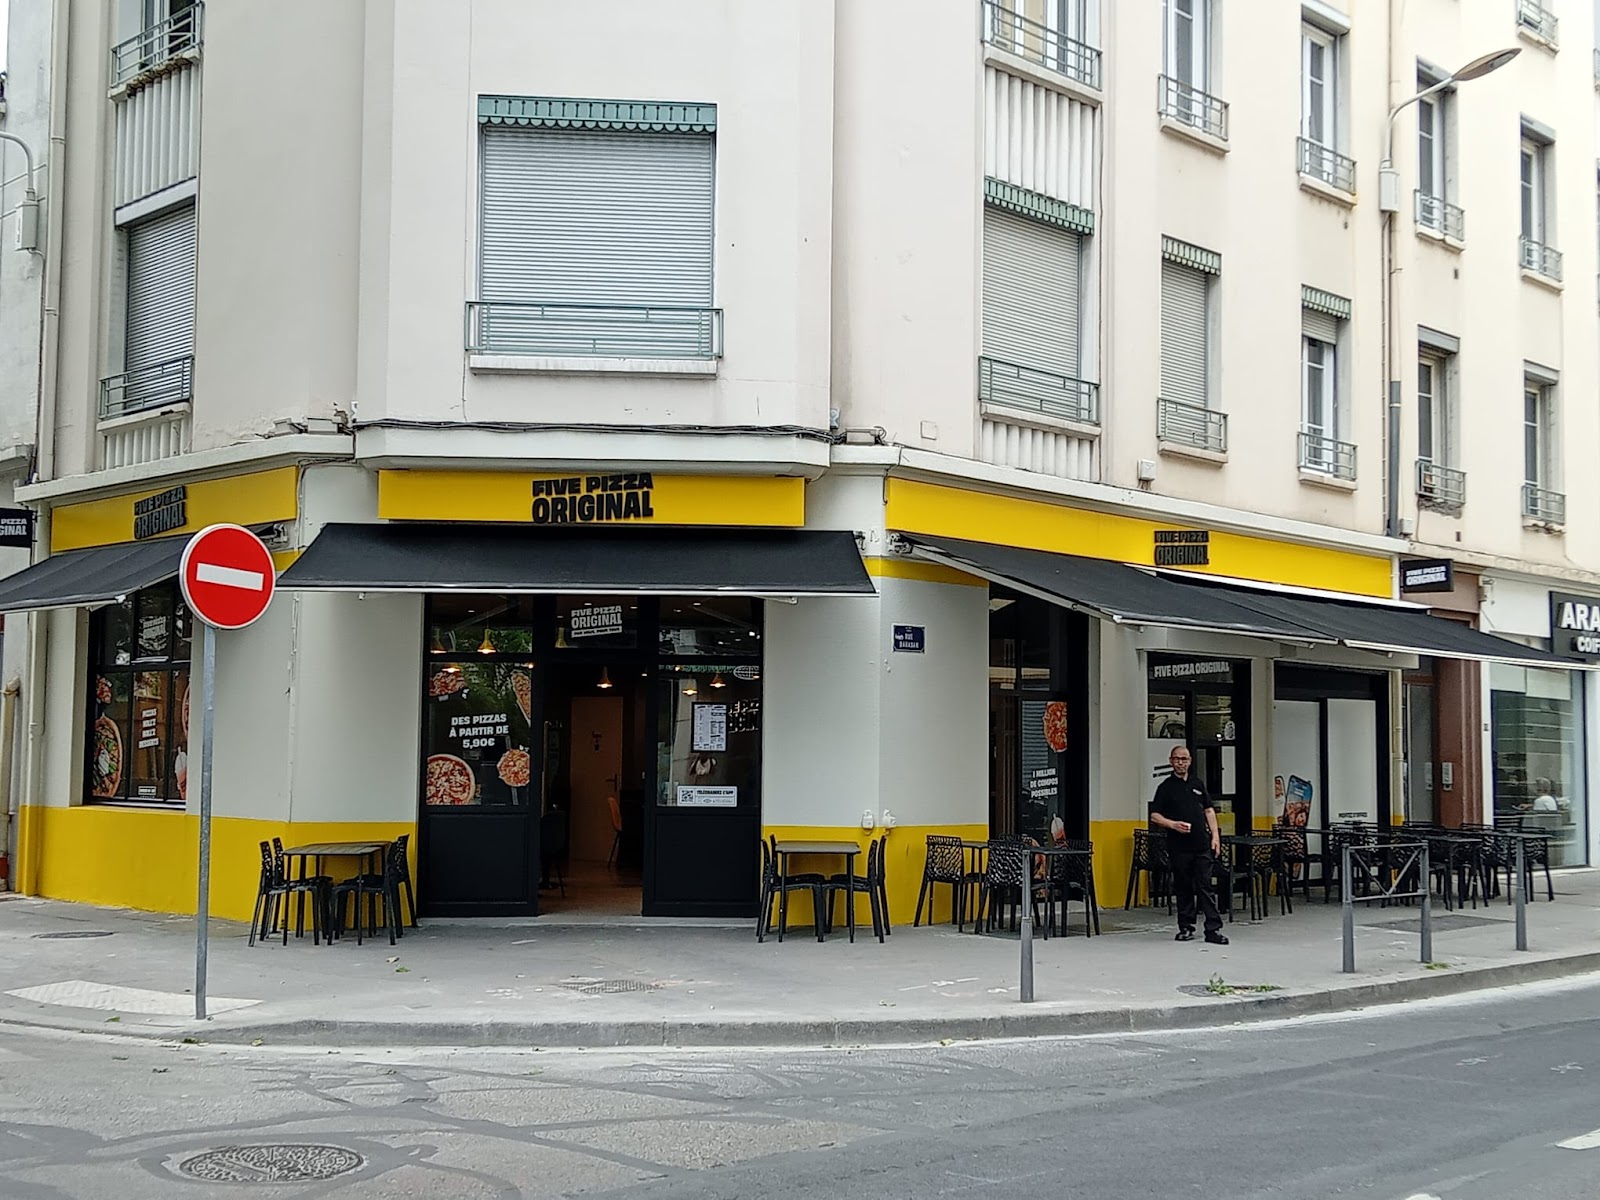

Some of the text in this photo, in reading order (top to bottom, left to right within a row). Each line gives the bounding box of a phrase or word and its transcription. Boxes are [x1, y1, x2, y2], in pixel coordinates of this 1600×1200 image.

[532, 472, 654, 497] FIVE PIZZA
[154, 485, 186, 509] PIZZA
[532, 490, 654, 524] ORIGINAL
[134, 501, 187, 540] ORIGINAL
[571, 605, 622, 617] FIVE PIZZA
[571, 613, 623, 629] ORIGINAL
[1154, 661, 1230, 678] FIVE PIZZA ORIGINAL
[451, 713, 507, 726] DES PIZZAS
[449, 725, 510, 738] À PARTIR DE
[462, 737, 496, 750] 5,90€
